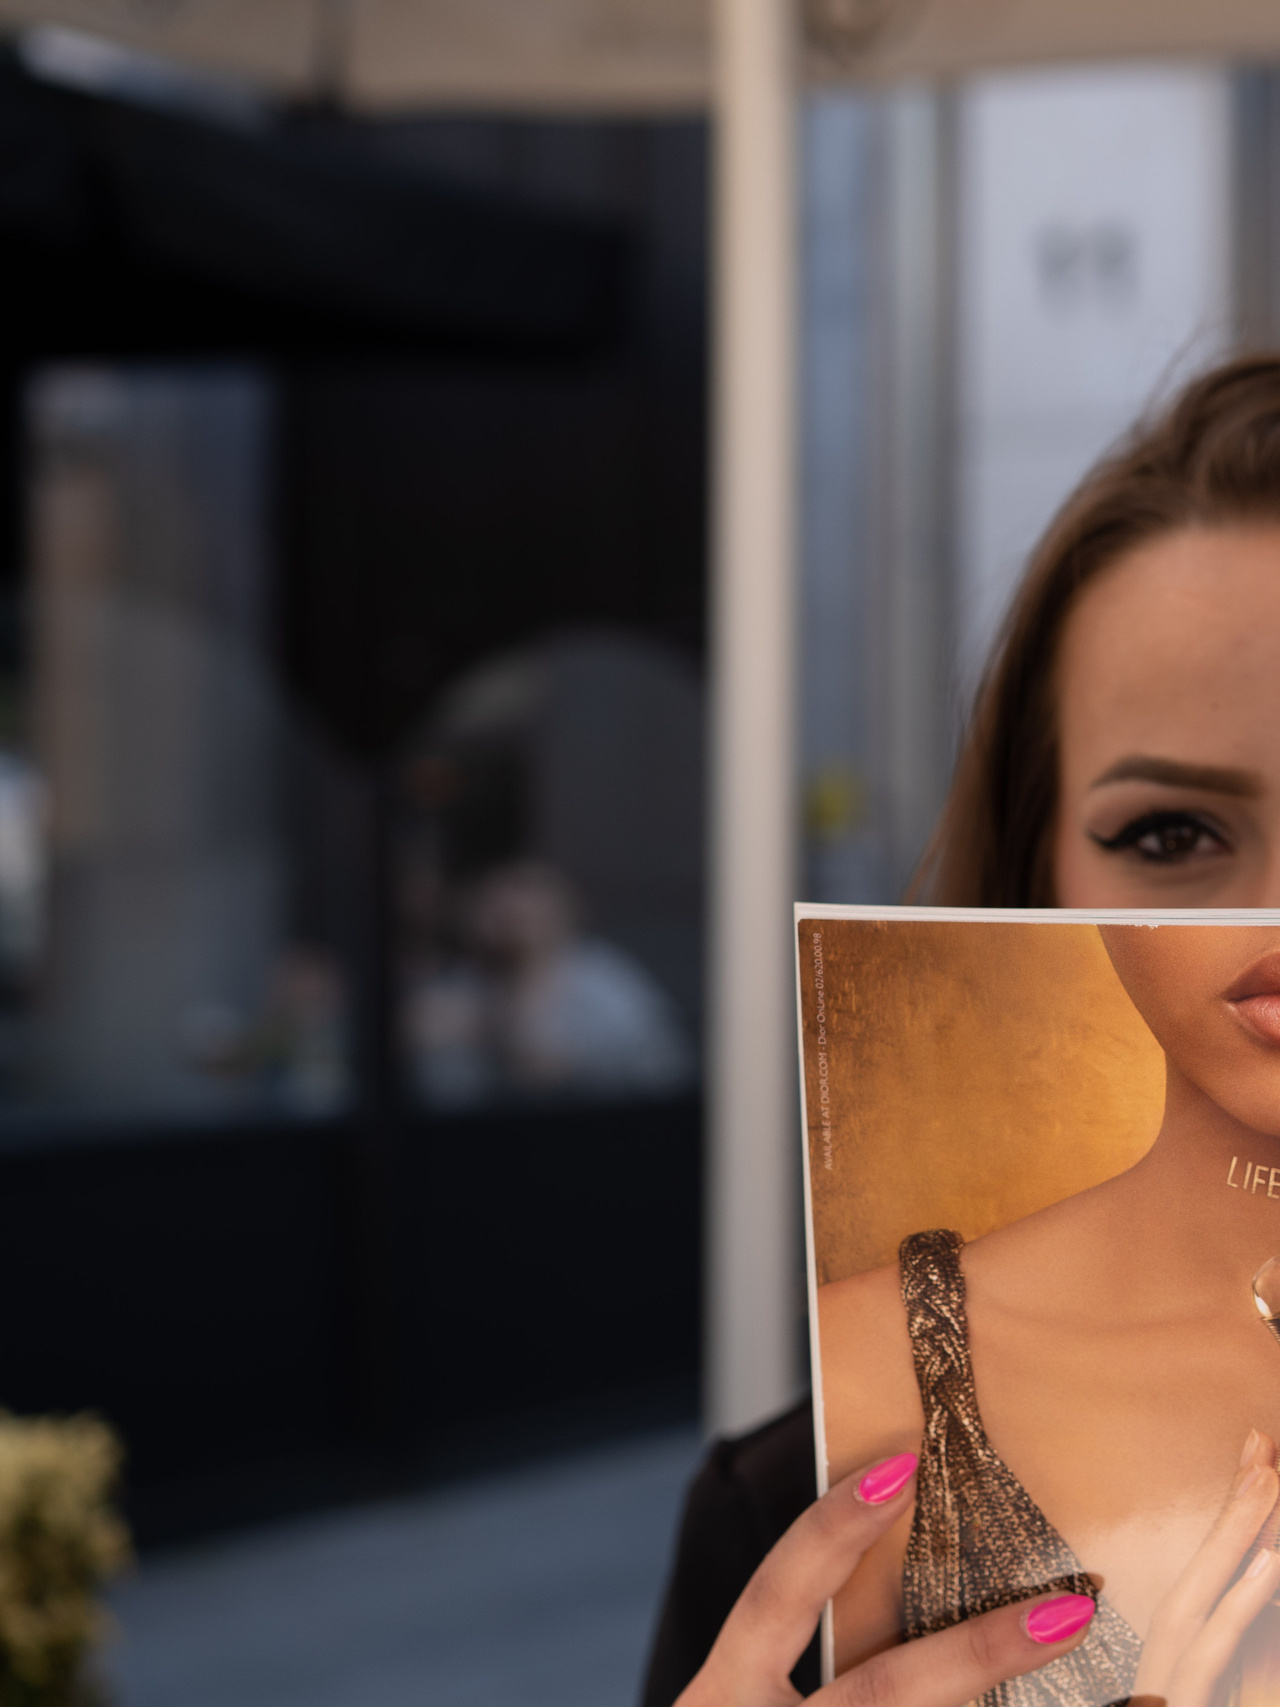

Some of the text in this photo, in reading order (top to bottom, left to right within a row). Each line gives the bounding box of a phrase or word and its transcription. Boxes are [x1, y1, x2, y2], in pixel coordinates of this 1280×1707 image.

[818, 1024, 827, 1045] Dior
[818, 1052, 830, 1104] DIOR.COM
[821, 1106, 830, 1119] AT
[822, 1120, 833, 1171] AVAILABLE
